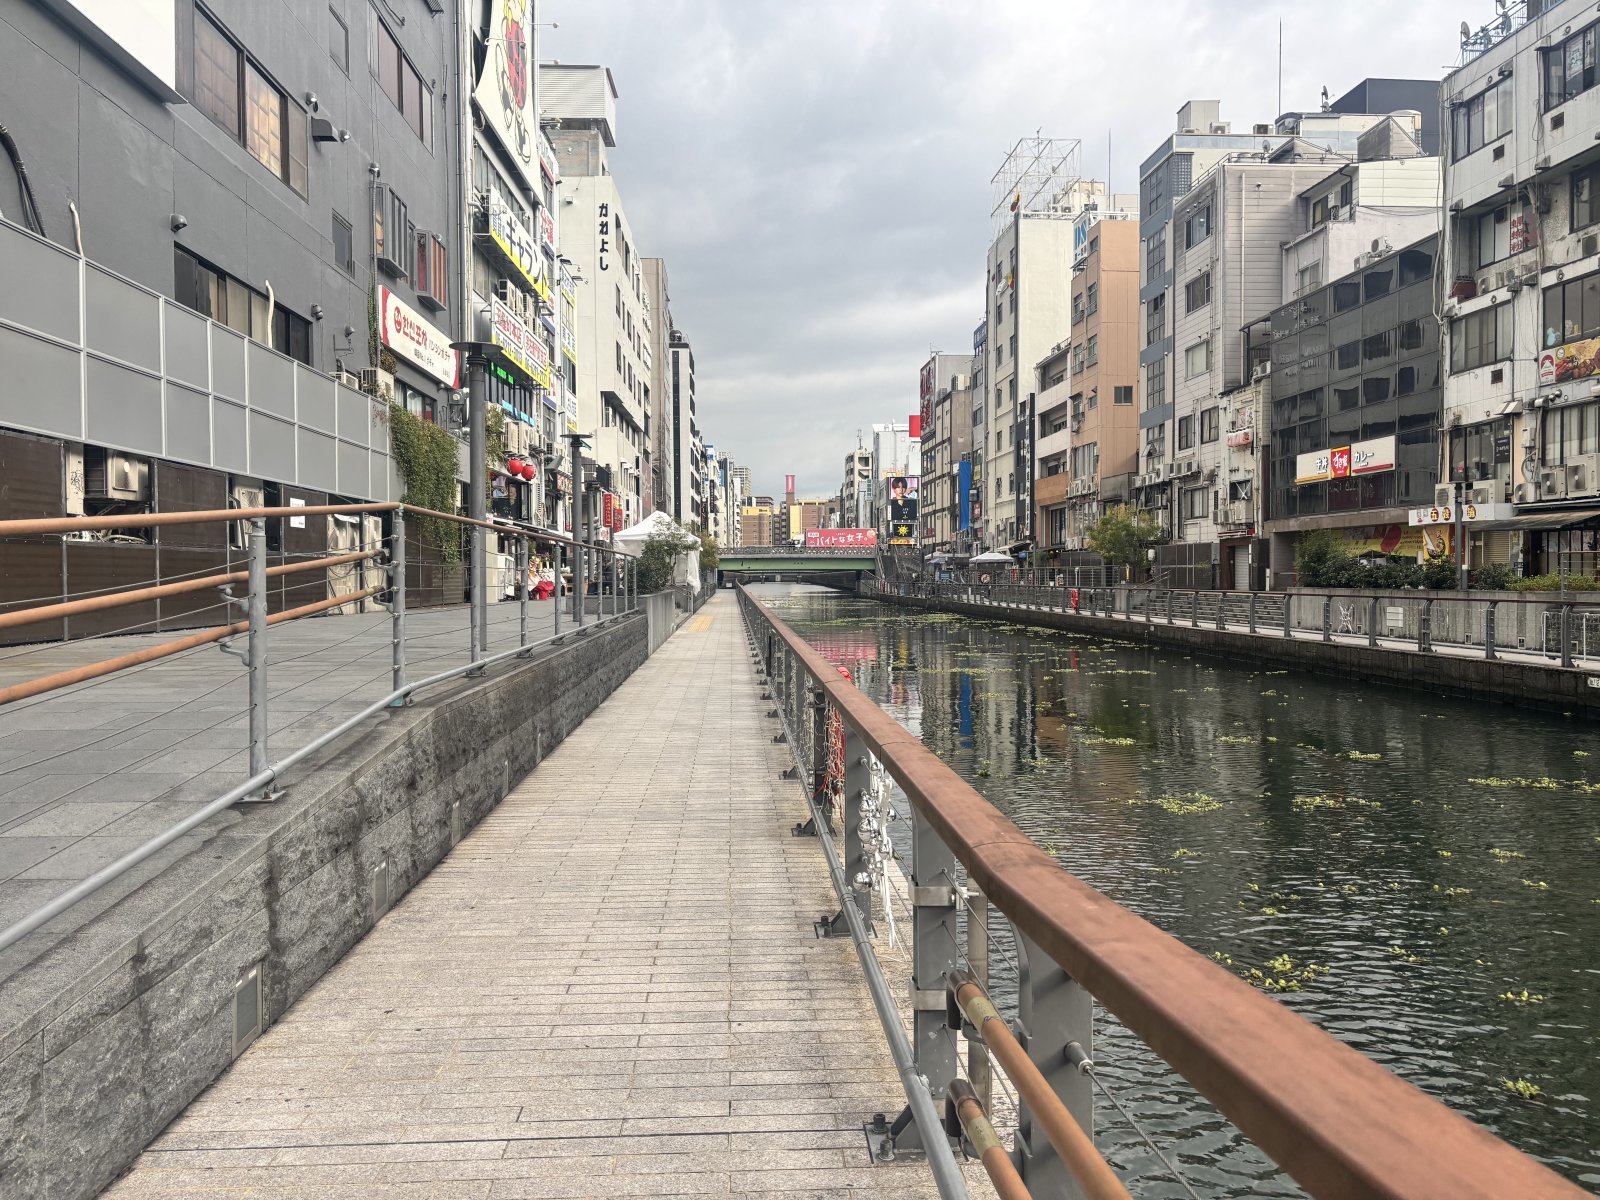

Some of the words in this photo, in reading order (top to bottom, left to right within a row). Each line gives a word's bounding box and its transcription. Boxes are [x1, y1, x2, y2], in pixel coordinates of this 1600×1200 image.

[599, 203, 608, 271] かねよし
[1316, 457, 1329, 469] 牛丼
[1354, 451, 1375, 463] カレー
